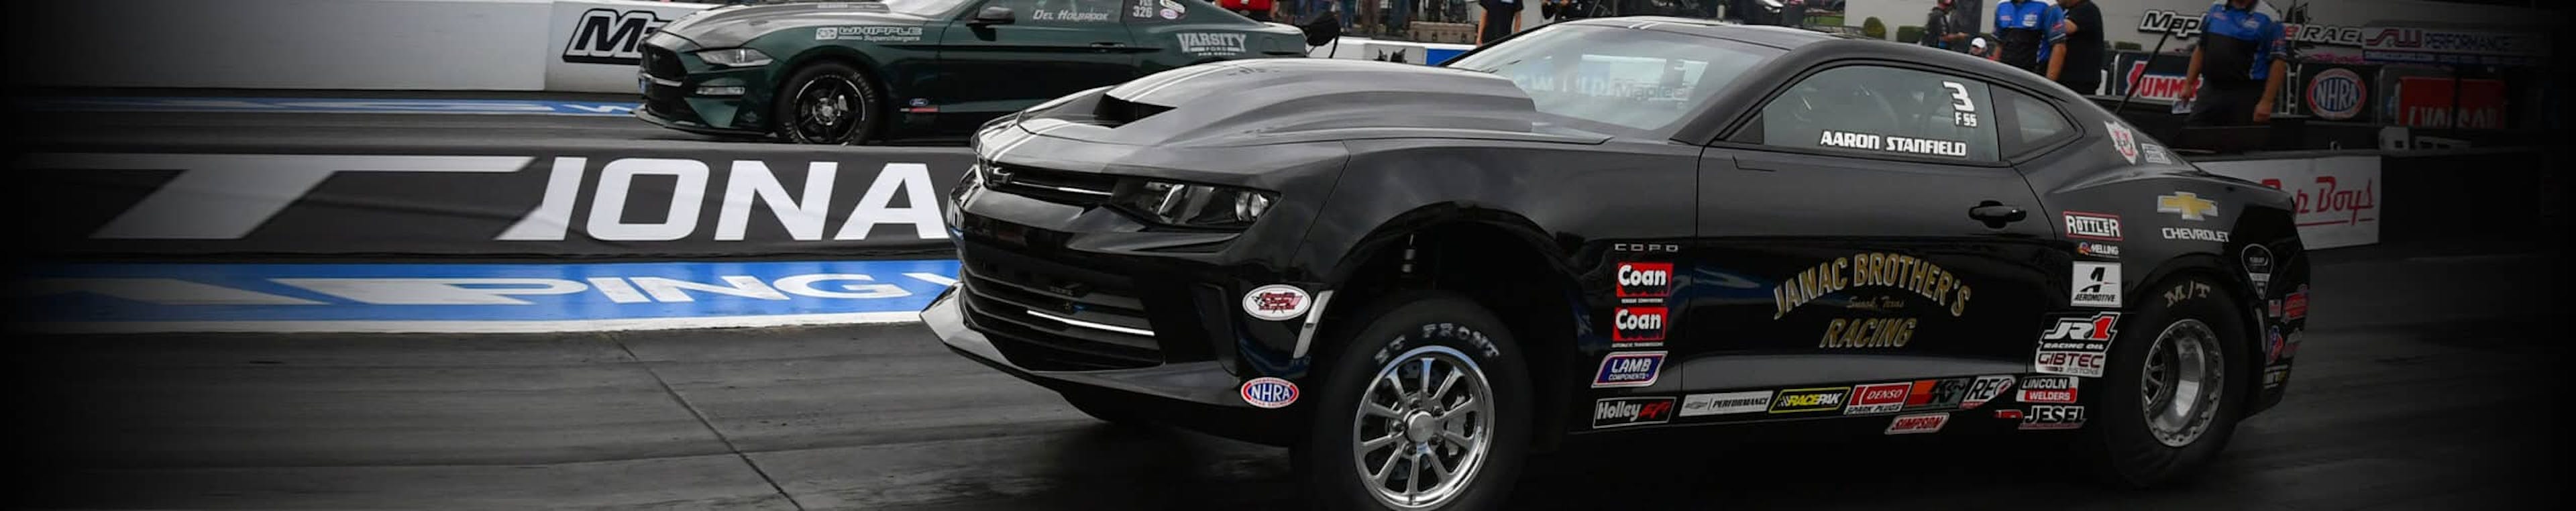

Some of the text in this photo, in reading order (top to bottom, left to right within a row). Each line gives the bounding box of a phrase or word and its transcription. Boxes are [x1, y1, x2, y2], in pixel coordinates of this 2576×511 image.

[1132, 5, 1152, 18] 326
[1176, 33, 1246, 54] VARSITY
[1943, 80, 1974, 112] 3
[2315, 78, 2359, 111] NHRA
[1820, 131, 1966, 156] AARON STANFIELD
[2065, 215, 2121, 237] ROTTLER
[2162, 227, 2231, 242] CHEVROLET
[1614, 243, 1678, 253] COPO
[2091, 243, 2120, 255] MELLING
[1618, 264, 1667, 286] Coan
[1773, 252, 1972, 321] JANAC BROTHER'S
[2163, 280, 2211, 308] M/T
[2074, 293, 2116, 302] AEROMOTIVE
[1615, 308, 1662, 330] Coan
[2043, 315, 2114, 341] JR1
[1422, 322, 1501, 357] FRONT
[1819, 317, 1918, 349] RACING
[1611, 357, 1652, 373] LAMB
[2038, 352, 2104, 368] GIBTEC
[1250, 384, 1291, 402] NHRA
[2021, 378, 2068, 390] LINCOLN
[1713, 397, 1769, 408] PERFORMANCE
[1784, 392, 1843, 406] RACEPAK
[1867, 389, 1904, 400] DENSO
[2031, 390, 2071, 402] WELDERS
[1596, 400, 1643, 422] Holley
[1892, 416, 1943, 431] SIMPSON
